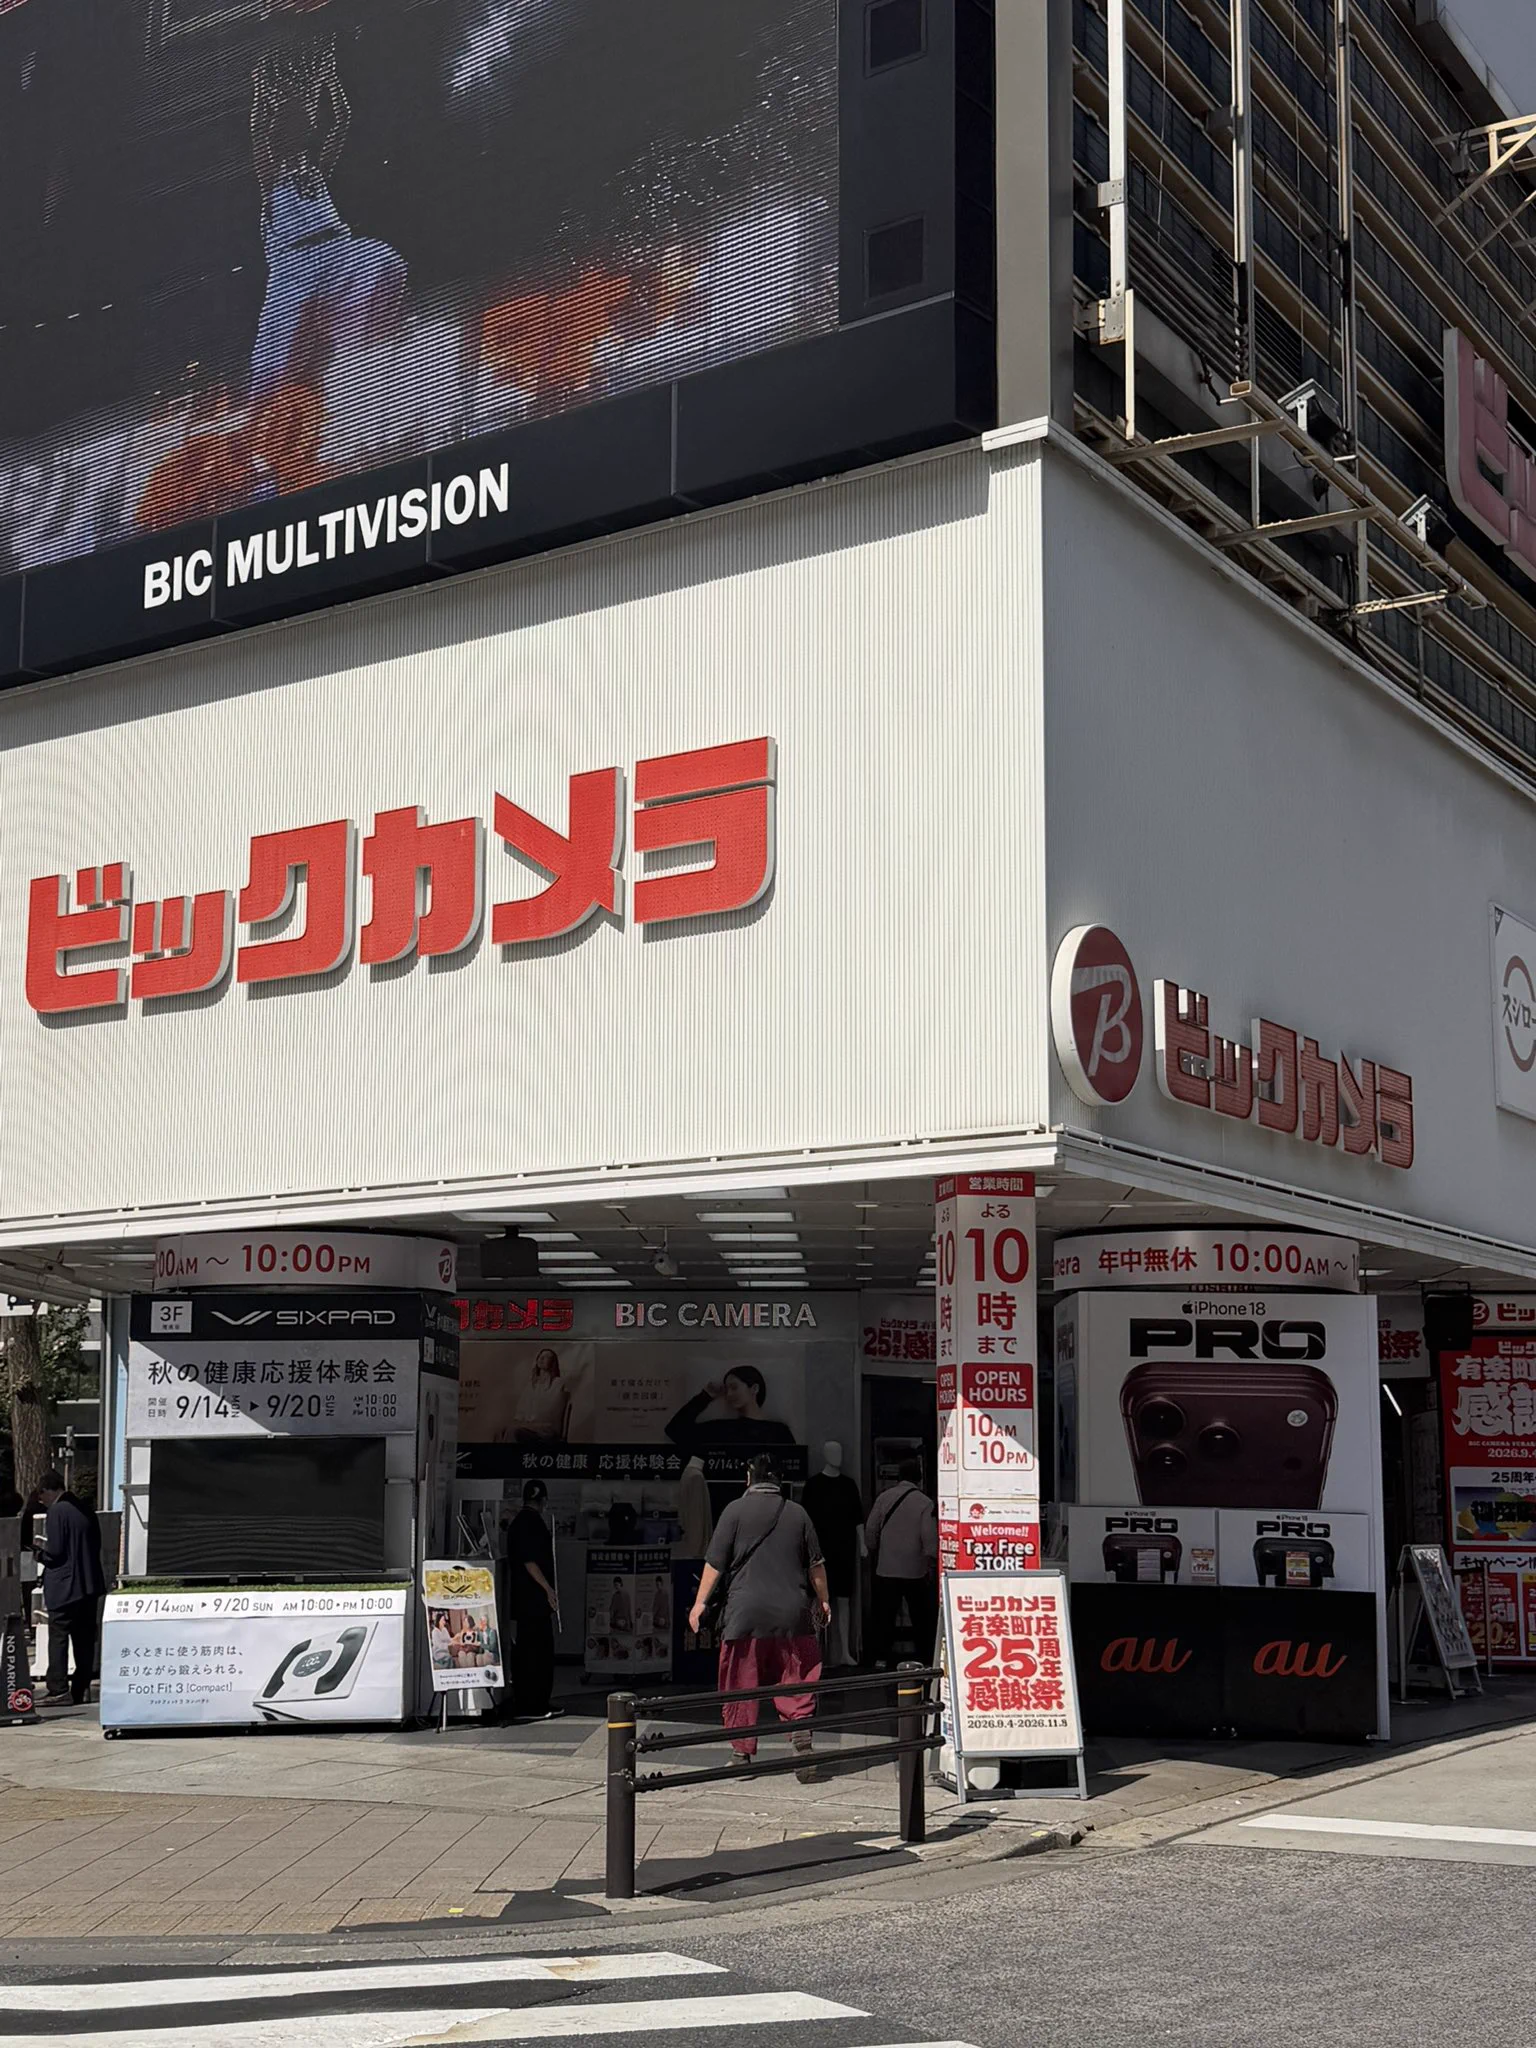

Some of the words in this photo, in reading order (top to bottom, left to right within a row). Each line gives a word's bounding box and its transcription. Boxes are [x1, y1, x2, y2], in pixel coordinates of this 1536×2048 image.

[144, 549, 213, 609] BIC
[227, 462, 510, 587] MULTIVISION
[26, 735, 776, 1014] ビックカメラ
[1153, 978, 1414, 1169] ビックカメラ
[969, 1177, 1024, 1191] 営業時間
[981, 1203, 1011, 1219] よる
[242, 1244, 371, 1273] 10:00PM
[937, 1230, 956, 1286] 10
[965, 1228, 1030, 1284] 10
[1099, 1247, 1198, 1273] 年中無休
[1212, 1243, 1330, 1276] 10:00AM
[160, 1306, 184, 1321] 3F
[615, 1302, 668, 1328] BIC
[677, 1302, 818, 1328] CAMERA
[977, 1291, 1017, 1331] 時
[1194, 1301, 1247, 1315] iPhone
[1249, 1302, 1266, 1315] 18
[275, 1310, 396, 1326] SIXPAD
[977, 1335, 1018, 1355] まで
[1130, 1318, 1326, 1359] PRO
[148, 1359, 397, 1385] 秋の健康応援体験会
[975, 1370, 1021, 1386] OPEN
[365, 1394, 397, 1405] 10:00
[969, 1387, 1027, 1403] HOURS
[176, 1395, 229, 1419] 9/14
[267, 1394, 321, 1418] 9/20
[325, 1394, 335, 1416] SUN
[365, 1406, 397, 1417] 10:00
[522, 1453, 589, 1469] 秋の健康
[599, 1454, 682, 1471] 応援体験会
[1491, 1471, 1536, 1483] 25周年
[971, 1524, 1029, 1537] Welcome!!
[1106, 1517, 1178, 1533] PRO
[1257, 1521, 1330, 1538] PRO
[963, 1538, 995, 1555] Tax
[998, 1539, 1035, 1555] Free
[974, 1555, 1024, 1570] STORE
[135, 1599, 169, 1613] 9/14
[171, 1604, 194, 1613] MON
[213, 1598, 249, 1612] 9/20
[252, 1602, 273, 1611] SUN
[283, 1601, 298, 1610] AM
[301, 1599, 334, 1610] 10:00
[343, 1601, 357, 1610] PM
[360, 1598, 393, 1609] 10:00
[957, 1596, 1056, 1612] ビックカメラ
[959, 1614, 1058, 1637] 有楽町店
[6, 1635, 16, 1654] NO
[120, 1646, 243, 1658] 歩くときに使う筋肉は、
[1100, 1636, 1193, 1673] au
[1254, 1640, 1348, 1679] au
[128, 1683, 154, 1695] Foot
[157, 1682, 172, 1694] Fit
[175, 1682, 184, 1694] 3
[966, 1679, 1066, 1712] 感謝祭
